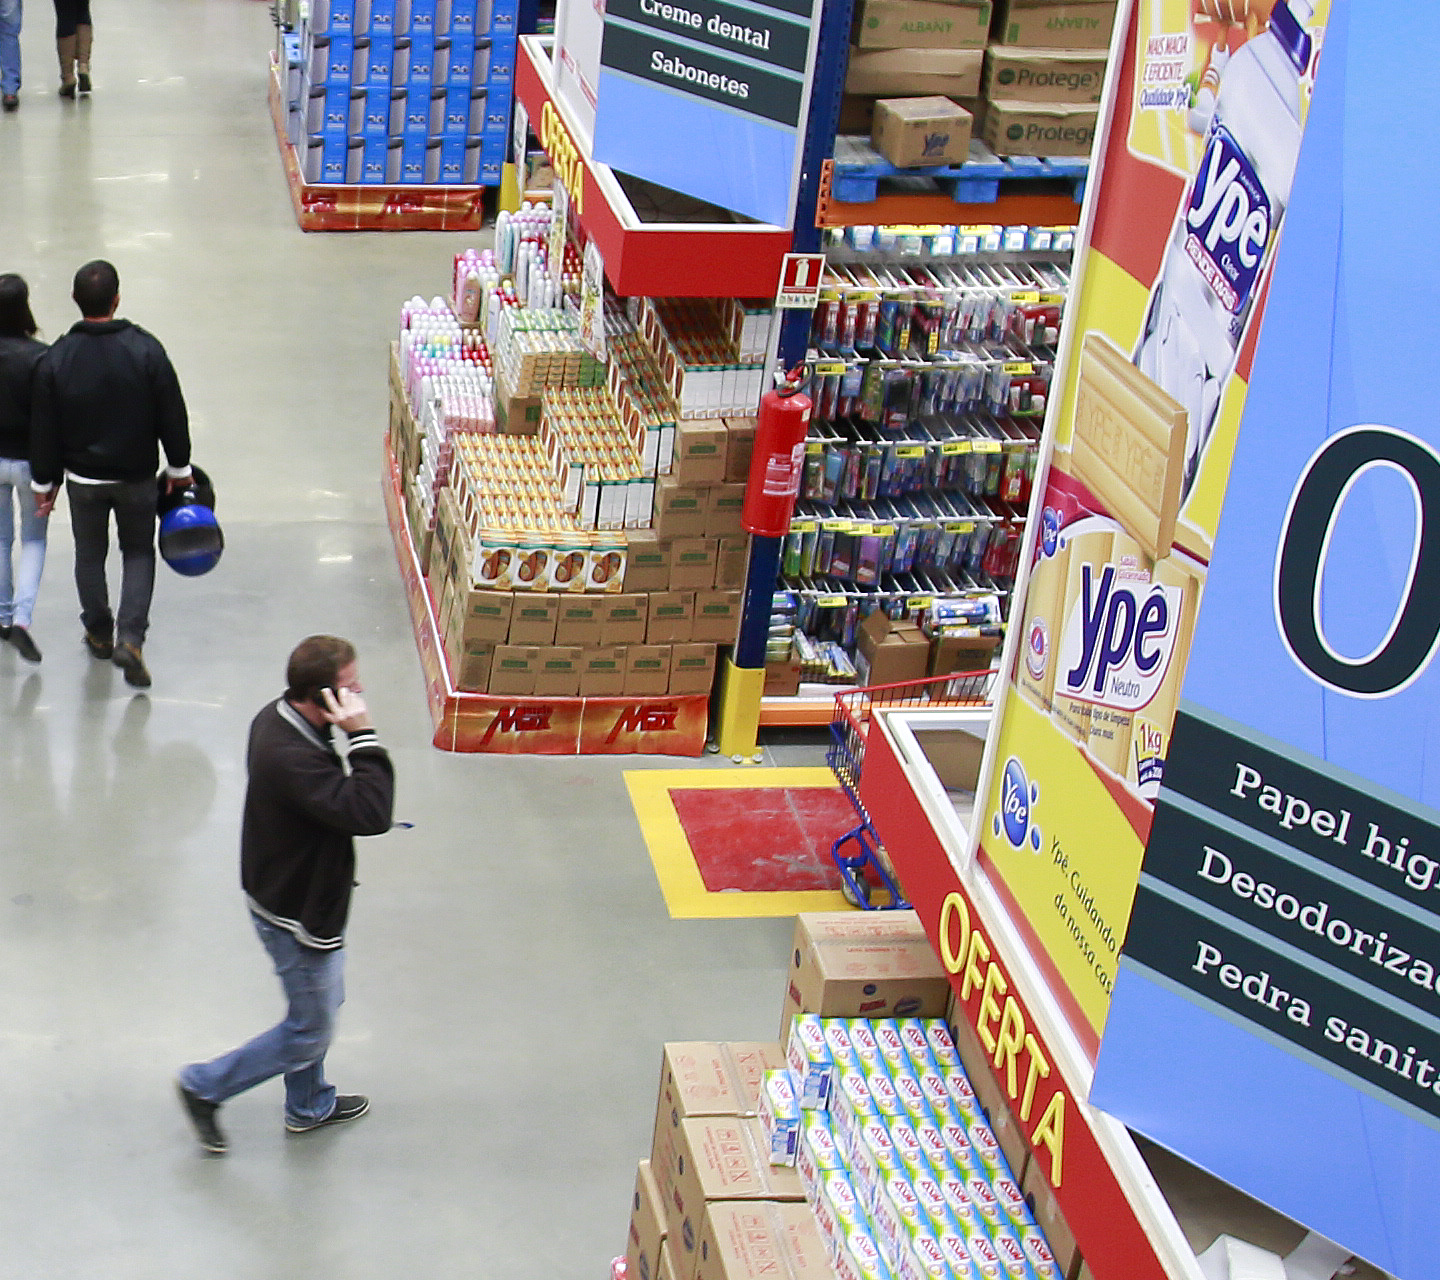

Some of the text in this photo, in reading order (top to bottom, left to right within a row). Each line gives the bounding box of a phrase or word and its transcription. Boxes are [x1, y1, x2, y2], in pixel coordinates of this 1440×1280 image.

[706, 14, 771, 50] dental
[900, 20, 953, 34] ALBANY
[1047, 17, 1100, 30] ALBANY
[650, 50, 750, 99] Sabonetes
[1019, 69, 1092, 91] Protege
[540, 102, 584, 215] OFERTA
[1187, 139, 1269, 269] Ypê
[1186, 236, 1236, 310] RENDE MAIS
[1067, 565, 1168, 693] Ypê
[1110, 675, 1141, 699] Neutro
[1110, 709, 1131, 727] limpeza
[1139, 723, 1163, 754] 1kg
[1229, 761, 1351, 846] Papel
[1053, 892, 1068, 918] da
[1066, 913, 1096, 968] nossa
[1069, 872, 1117, 953] Cuidando
[1191, 940, 1313, 1028] Pedra
[938, 890, 1066, 1188] OFERTA
